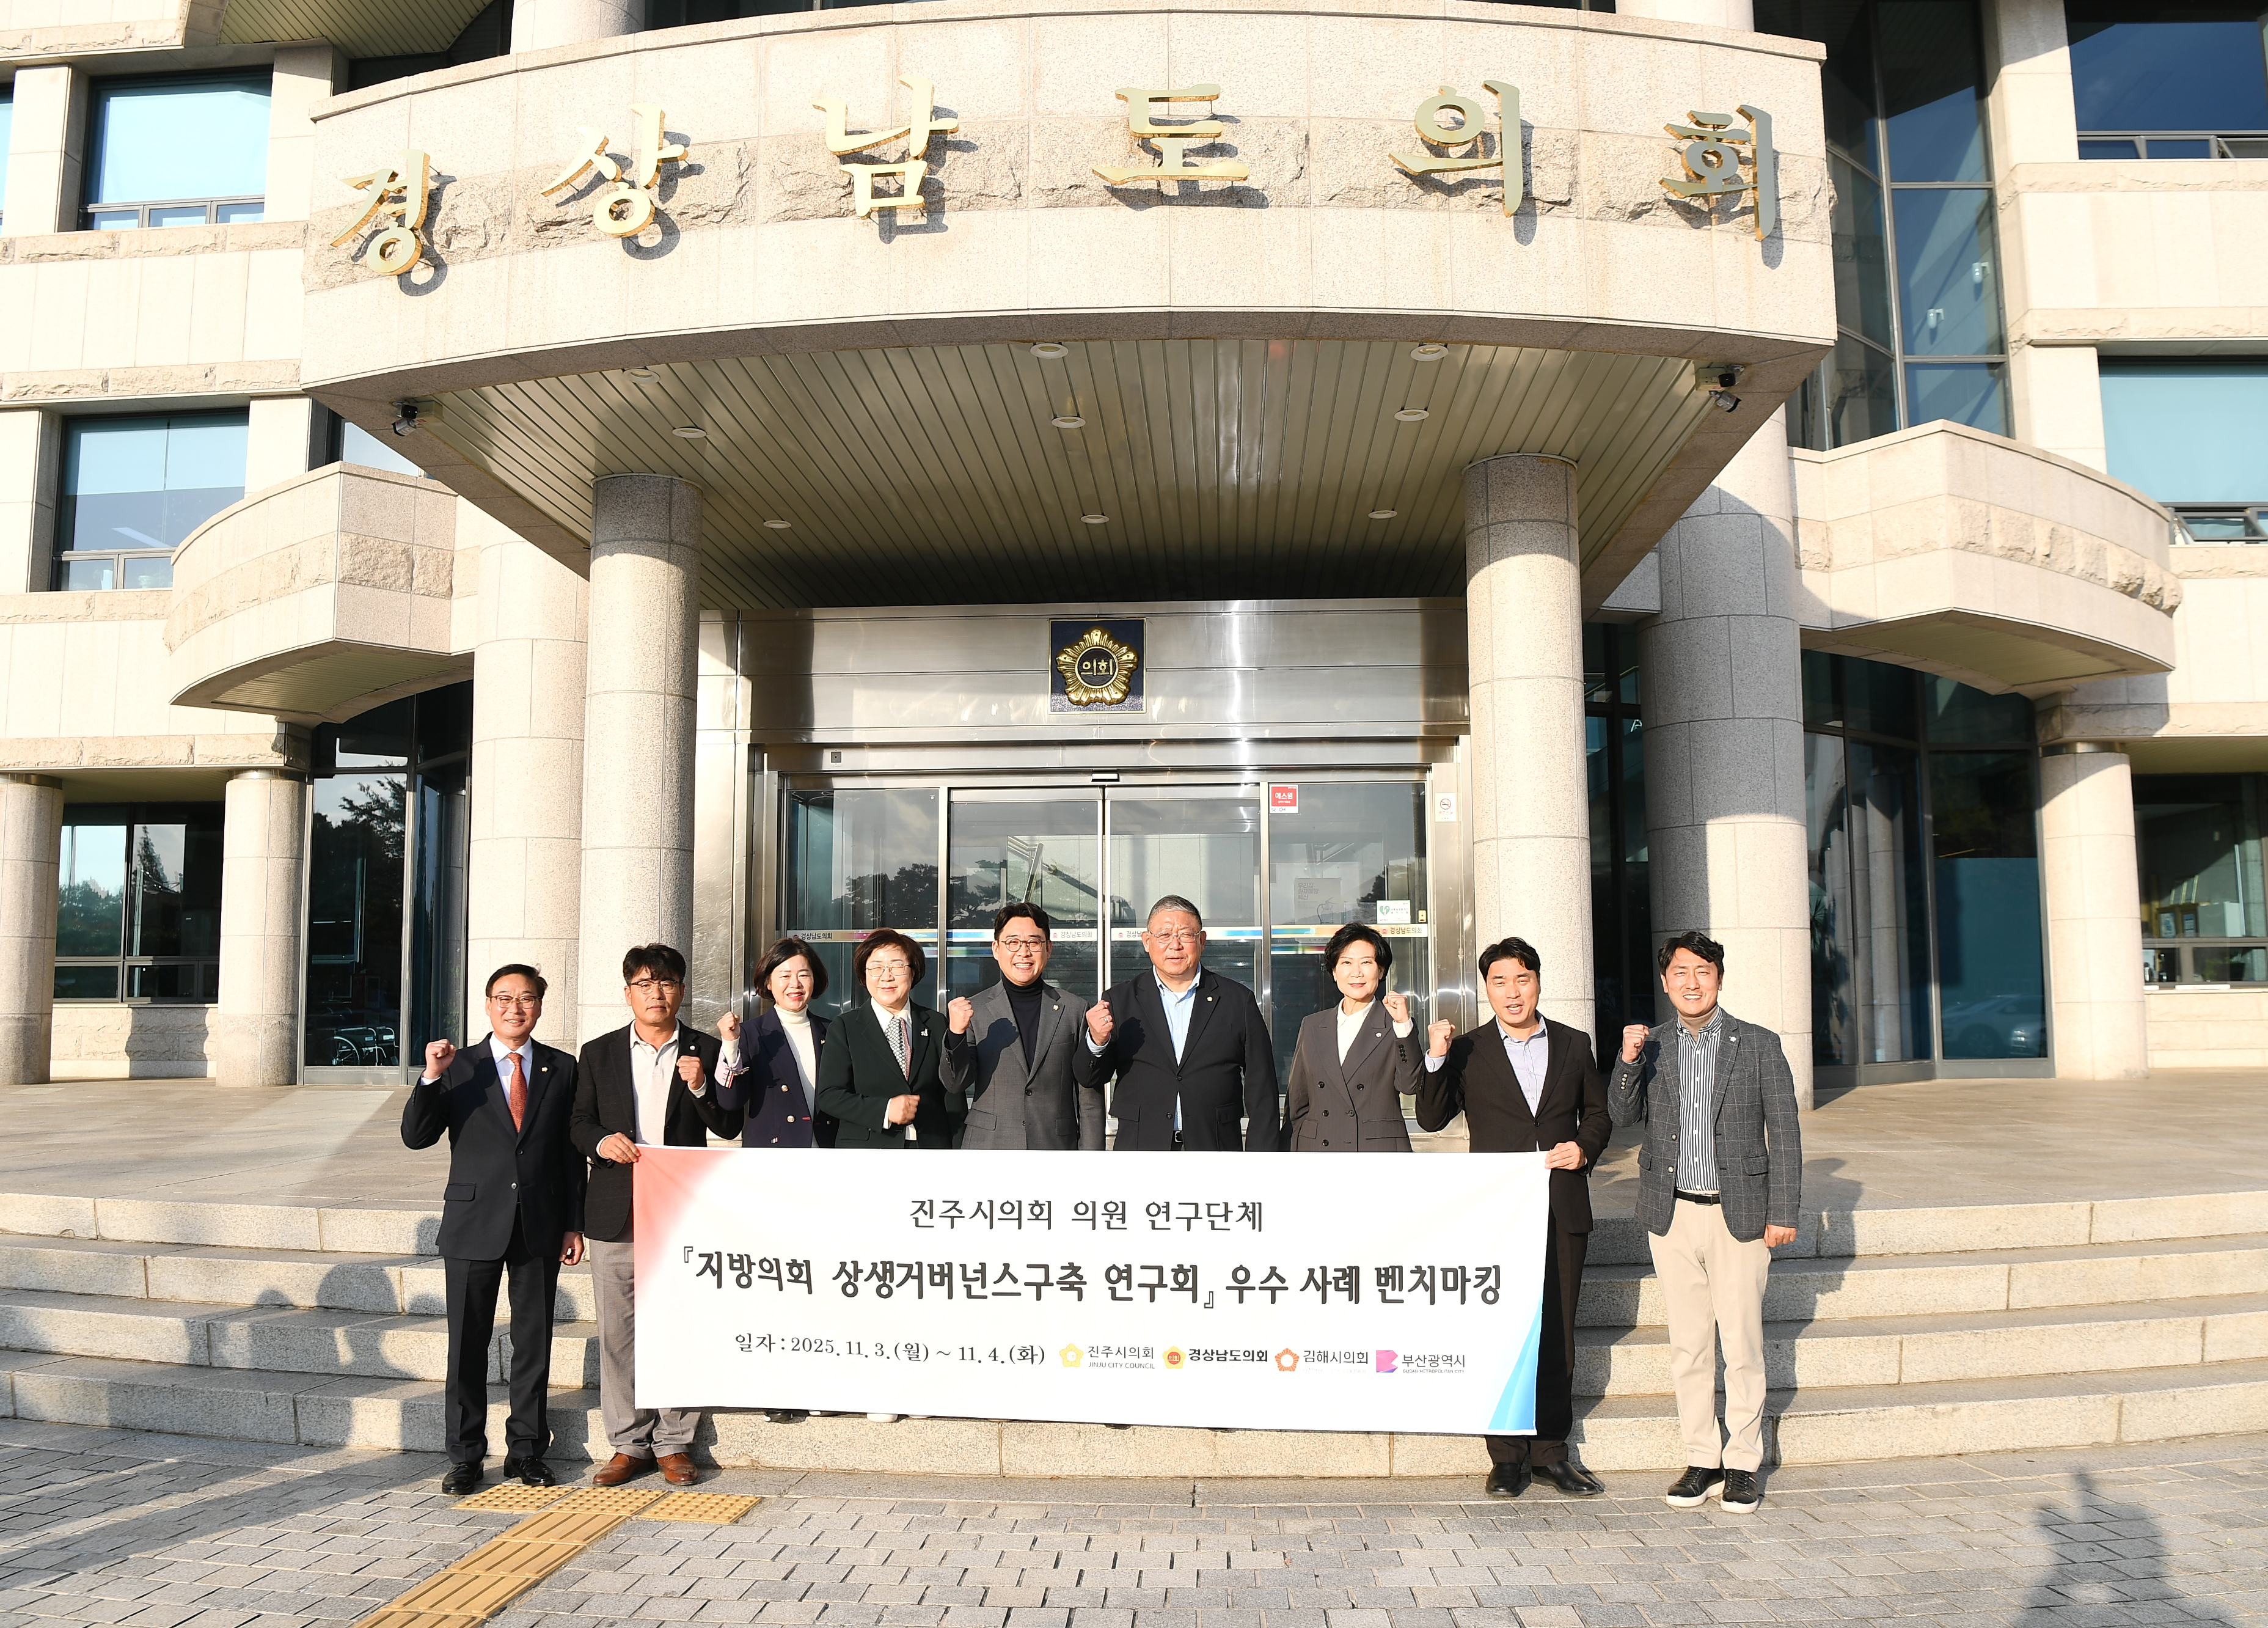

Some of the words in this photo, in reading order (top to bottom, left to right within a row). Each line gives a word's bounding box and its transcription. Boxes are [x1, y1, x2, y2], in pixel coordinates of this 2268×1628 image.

[330, 75, 1776, 276] 경상남도의회
[1081, 659, 1113, 675] 의회
[909, 1199, 1052, 1231] 진주시의회
[1071, 1200, 1128, 1231] 의원
[1145, 1201, 1262, 1233] 연구단체
[684, 1245, 813, 1295] 『지방의회
[832, 1260, 1088, 1302] 상생거버넌스구축
[1225, 1264, 1289, 1305] 우수
[1299, 1265, 1360, 1305] 사례
[1374, 1264, 1501, 1306] 벤치마킹
[1088, 1345, 1154, 1360] 진주시의회
[1188, 1349, 1268, 1362] 경상남도의회
[1303, 1350, 1369, 1365] 김해시의회
[1402, 1354, 1465, 1368] 부산광역시
